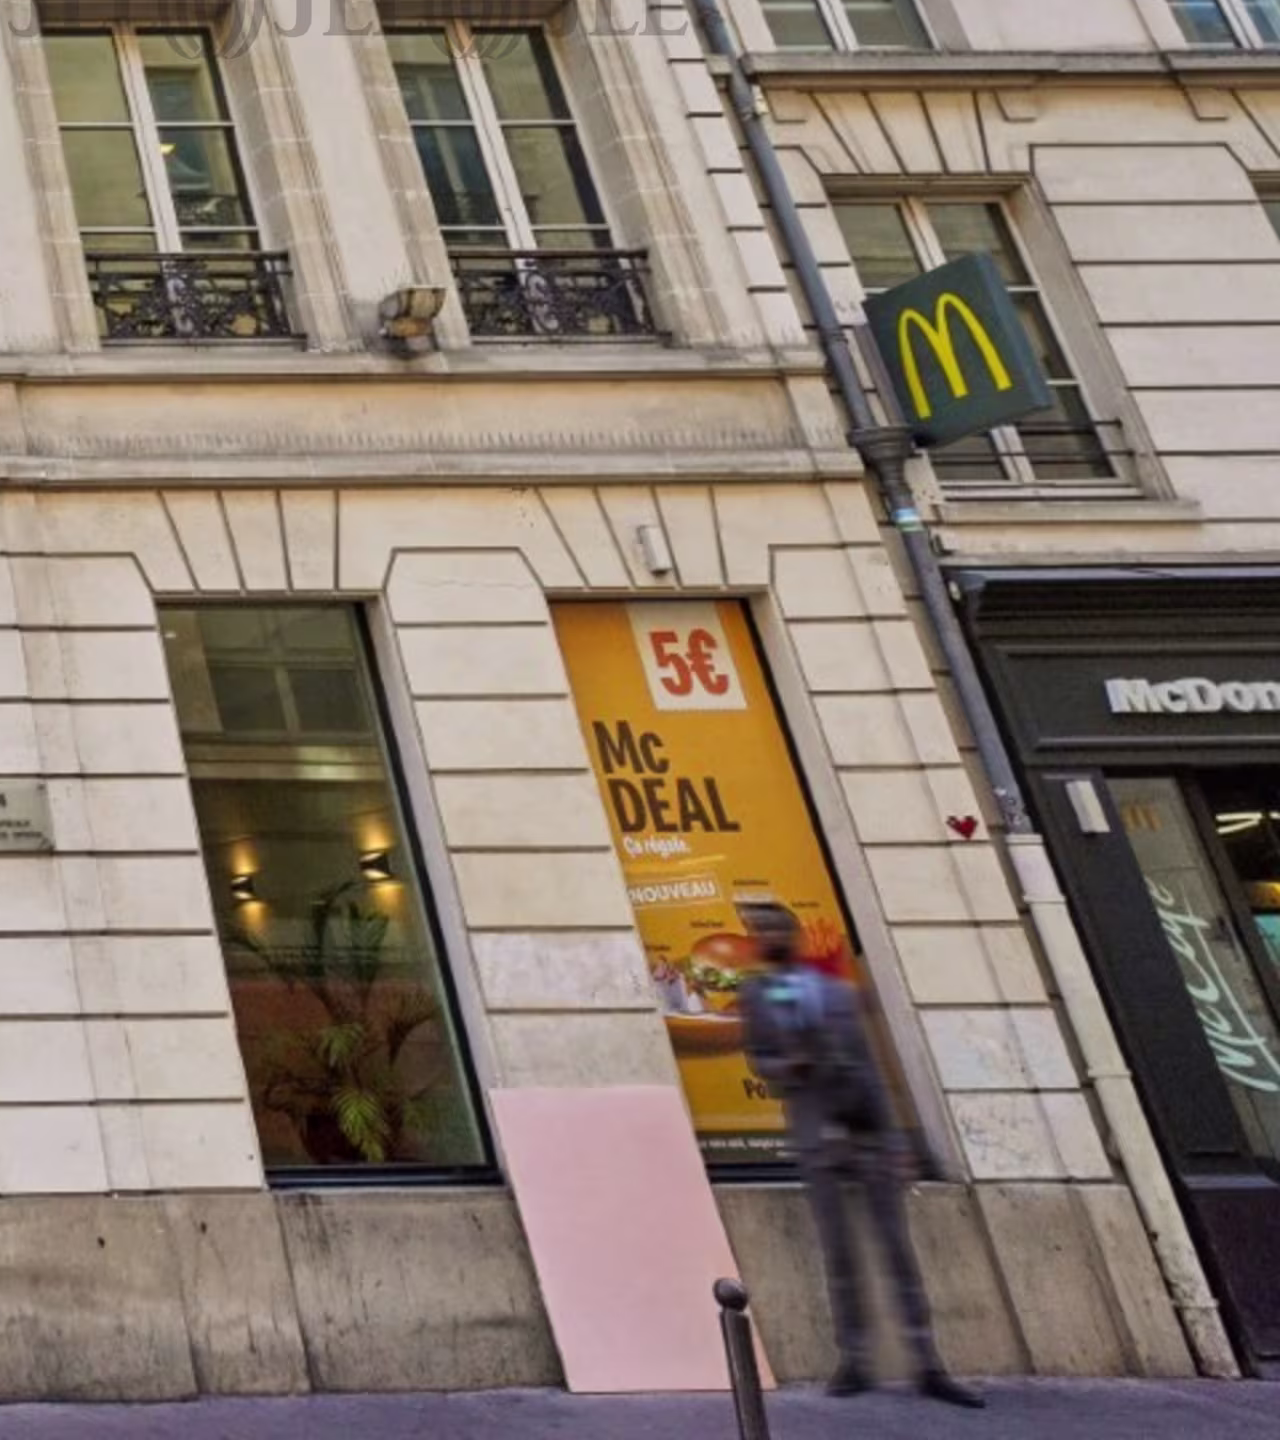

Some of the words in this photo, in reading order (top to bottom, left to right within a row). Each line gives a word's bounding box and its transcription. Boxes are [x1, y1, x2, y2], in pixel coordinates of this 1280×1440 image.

[649, 629, 729, 696] 5€
[592, 720, 670, 774] Mc
[608, 777, 740, 832] DEAL
[628, 879, 716, 904] NOUVEAU
